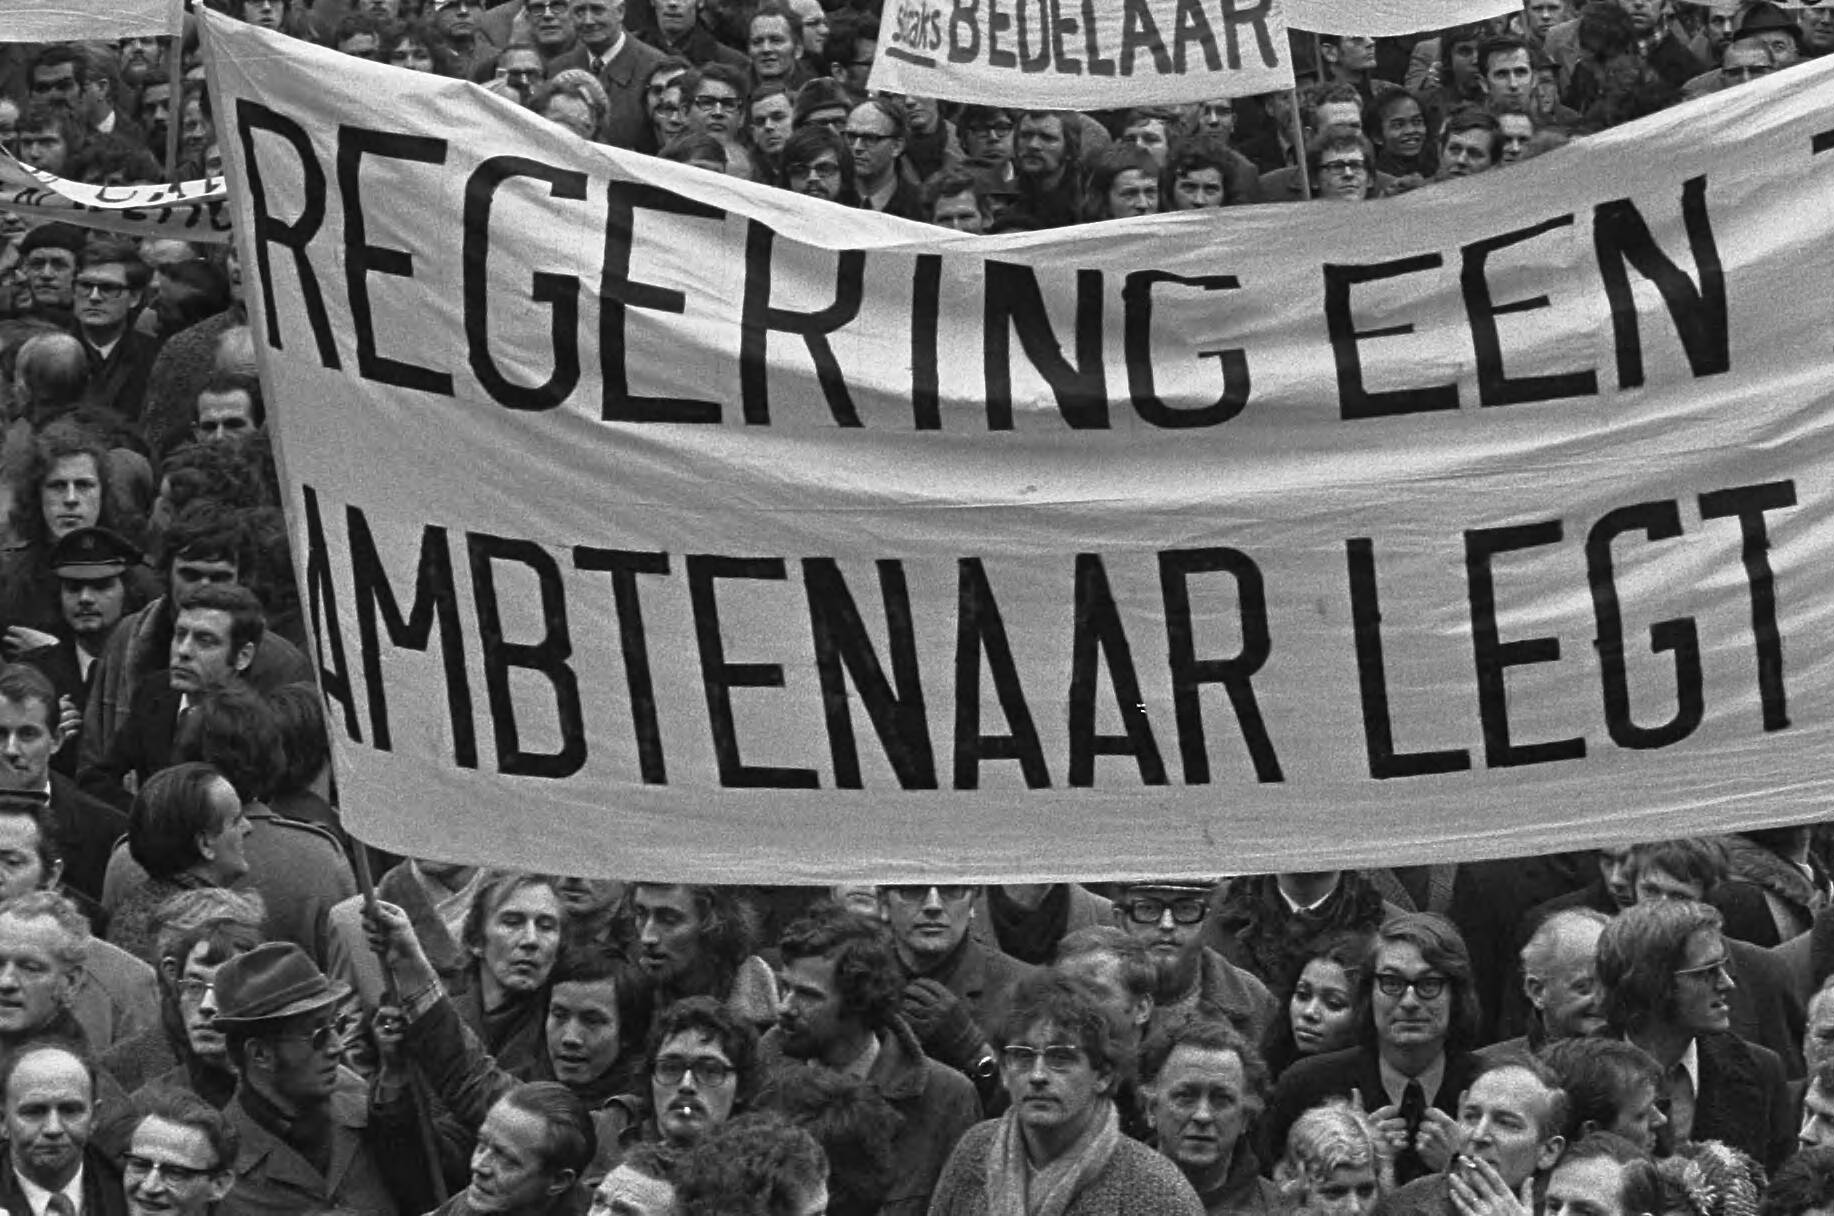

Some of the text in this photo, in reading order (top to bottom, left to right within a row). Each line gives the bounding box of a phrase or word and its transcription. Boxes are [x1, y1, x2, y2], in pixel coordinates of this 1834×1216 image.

[235, 98, 1251, 432] REGERING
[1322, 174, 1731, 421] EEN
[302, 482, 1285, 793] AMBTENAAR
[1346, 479, 1797, 781] LEGT
